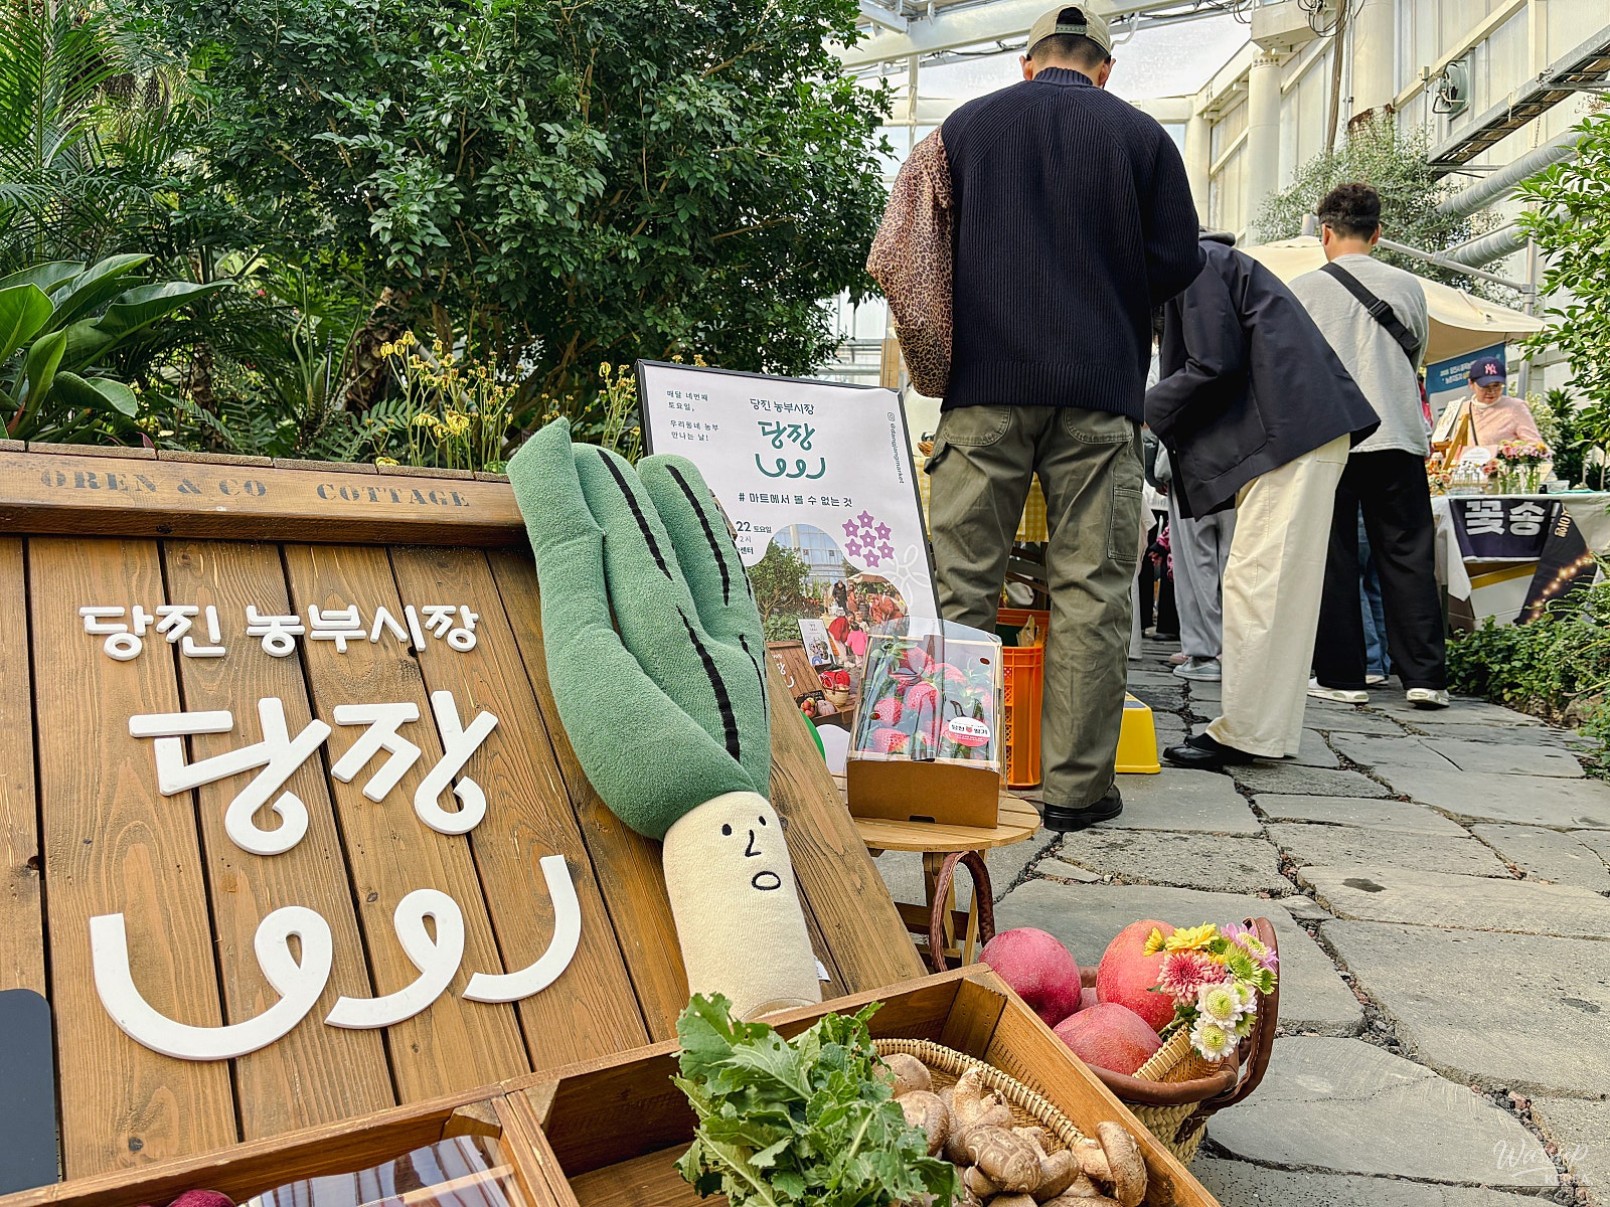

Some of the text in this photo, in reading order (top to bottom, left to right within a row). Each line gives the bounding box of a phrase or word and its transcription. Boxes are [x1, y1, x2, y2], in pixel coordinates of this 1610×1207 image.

[670, 419, 701, 430] 우리동네
[671, 431, 694, 440] 만나는
[40, 470, 470, 507] OREN & CO COTTAGE
[749, 492, 790, 504] 마트에서
[807, 495, 817, 505] 수
[820, 496, 840, 507] 없는
[843, 497, 853, 507] 것
[1464, 500, 1560, 535] 꽃송
[735, 521, 772, 533] 22 토요일
[738, 546, 754, 555] 센터
